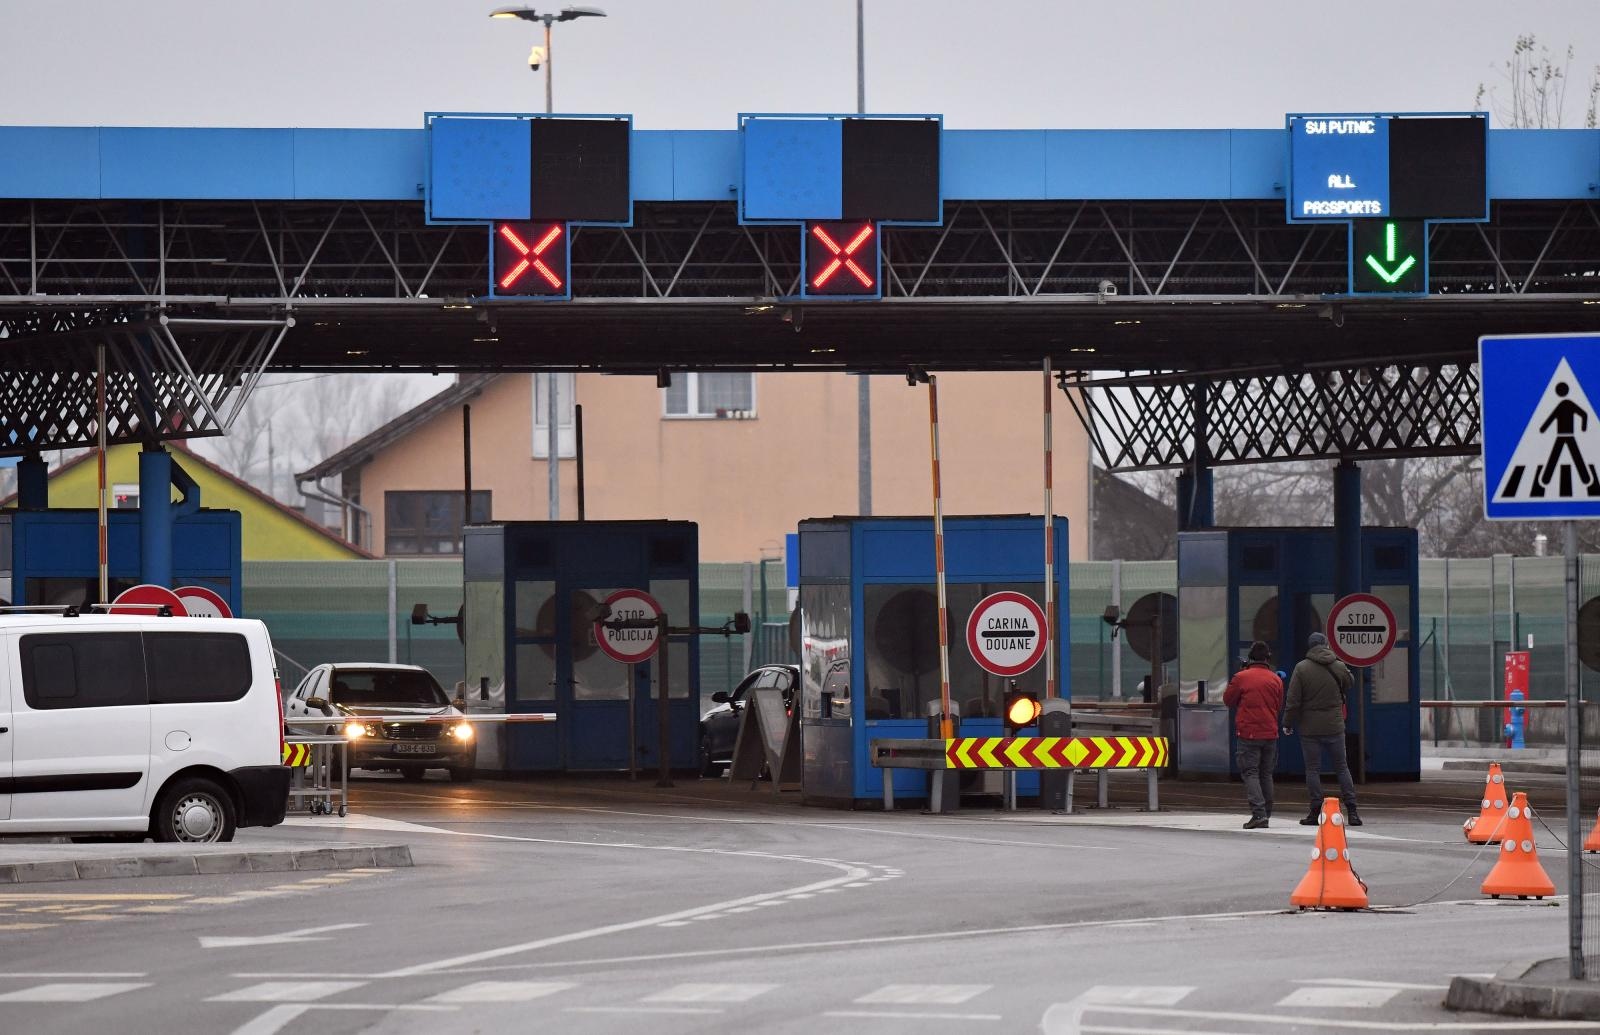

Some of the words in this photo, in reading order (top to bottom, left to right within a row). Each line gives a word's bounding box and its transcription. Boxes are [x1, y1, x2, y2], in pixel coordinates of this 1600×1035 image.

[1327, 174, 1357, 188] ALL
[1303, 200, 1382, 214] PASSPORTS
[617, 610, 645, 621] STOP
[1348, 613, 1375, 625] STOP
[988, 617, 1029, 630] CARINA
[608, 629, 653, 641] POLICIJA
[1339, 632, 1383, 645] POLICIJA
[986, 638, 1032, 651] DOUANE
